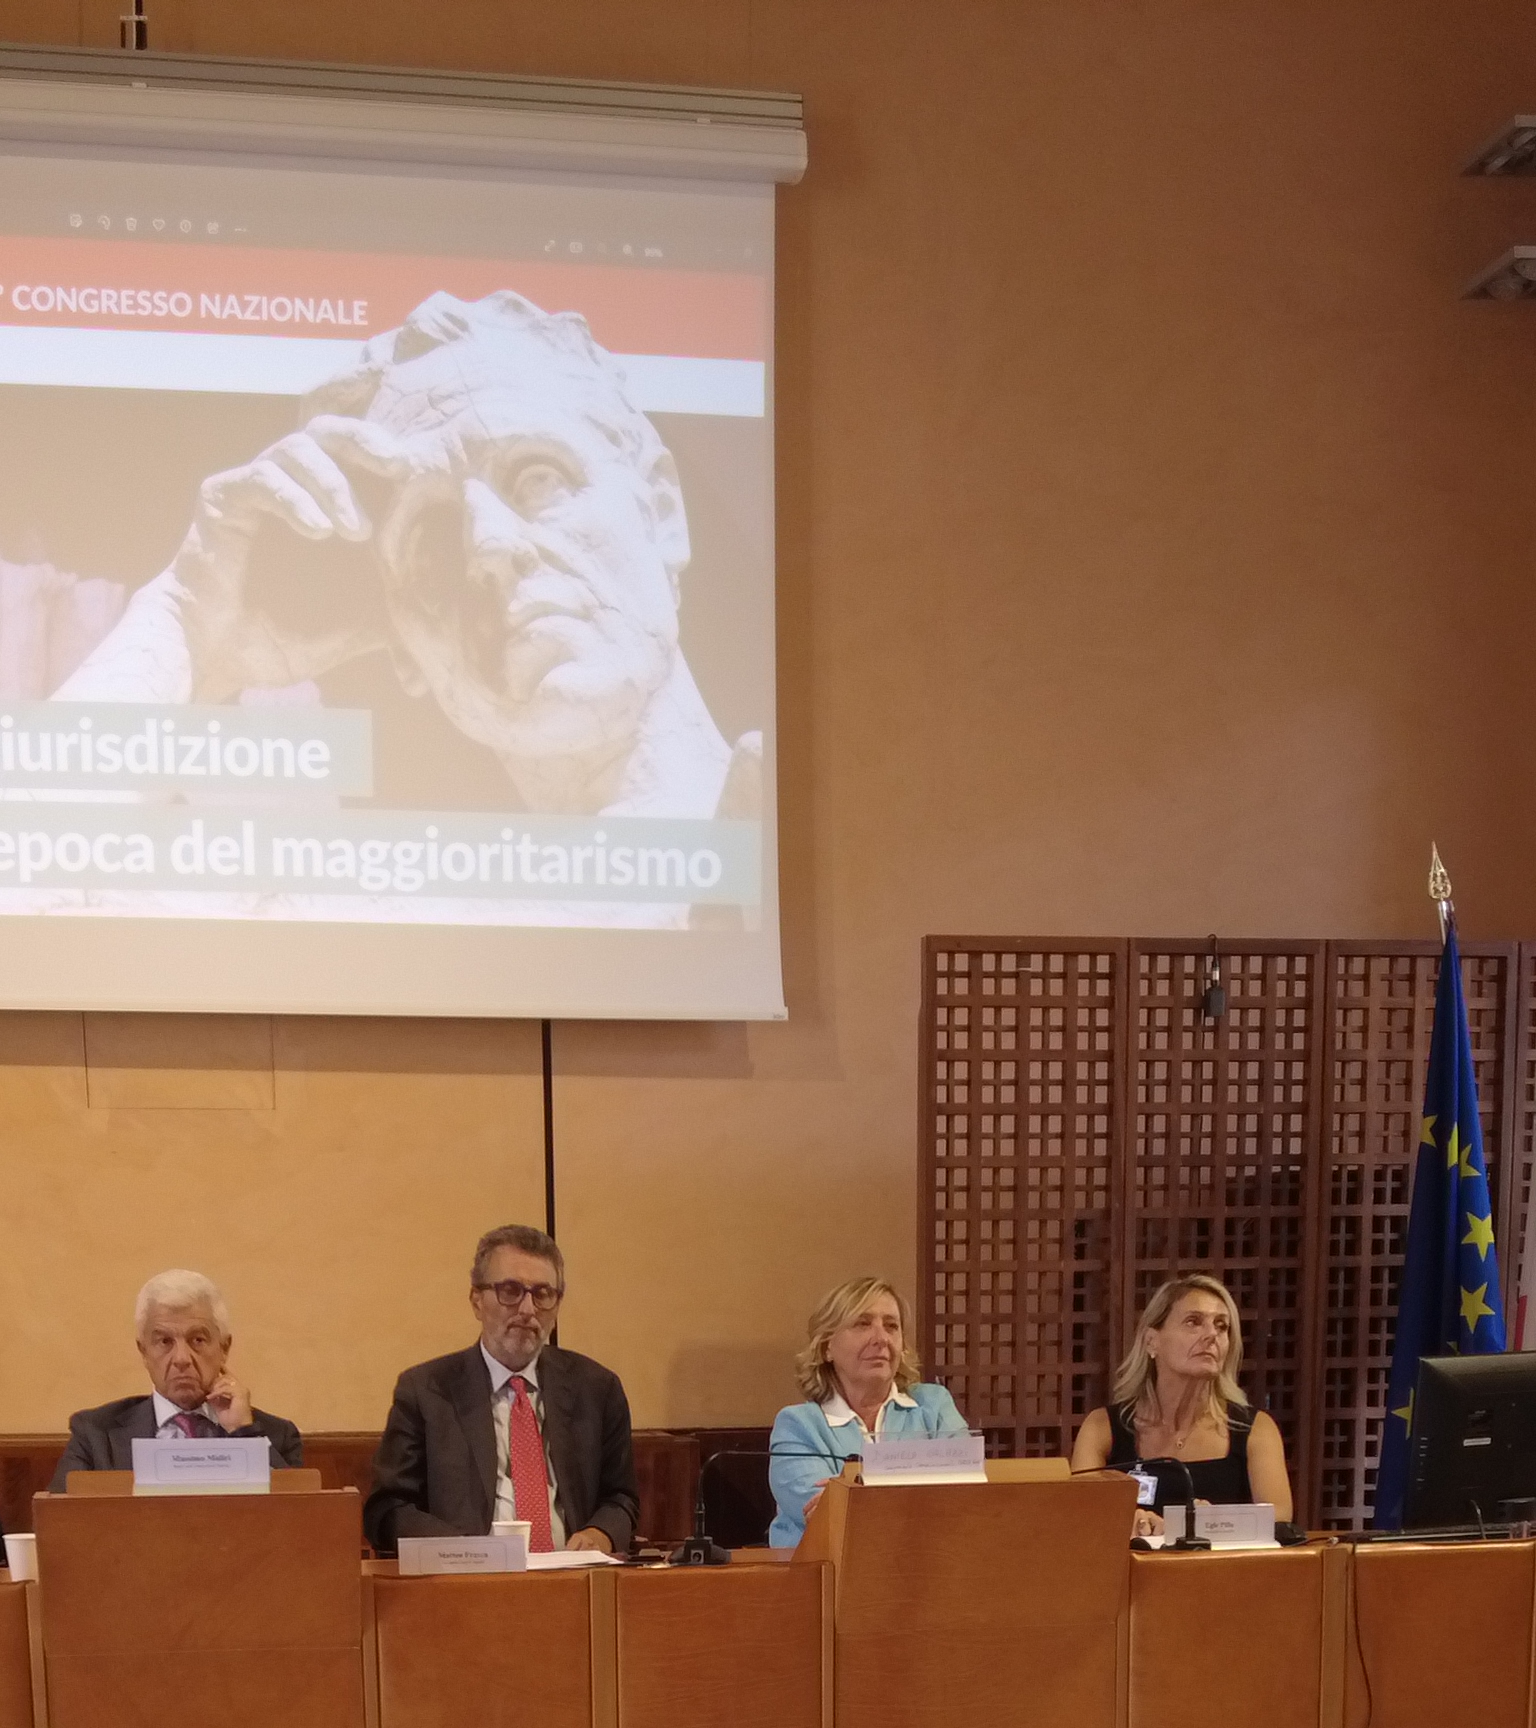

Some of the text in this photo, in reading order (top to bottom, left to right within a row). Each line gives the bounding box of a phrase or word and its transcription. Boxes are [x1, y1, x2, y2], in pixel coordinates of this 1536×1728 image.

[12, 285, 193, 318] CONGRESSO
[200, 293, 368, 325] NAZIONALE
[169, 819, 256, 876] del
[272, 827, 724, 891] maggioritarismo
